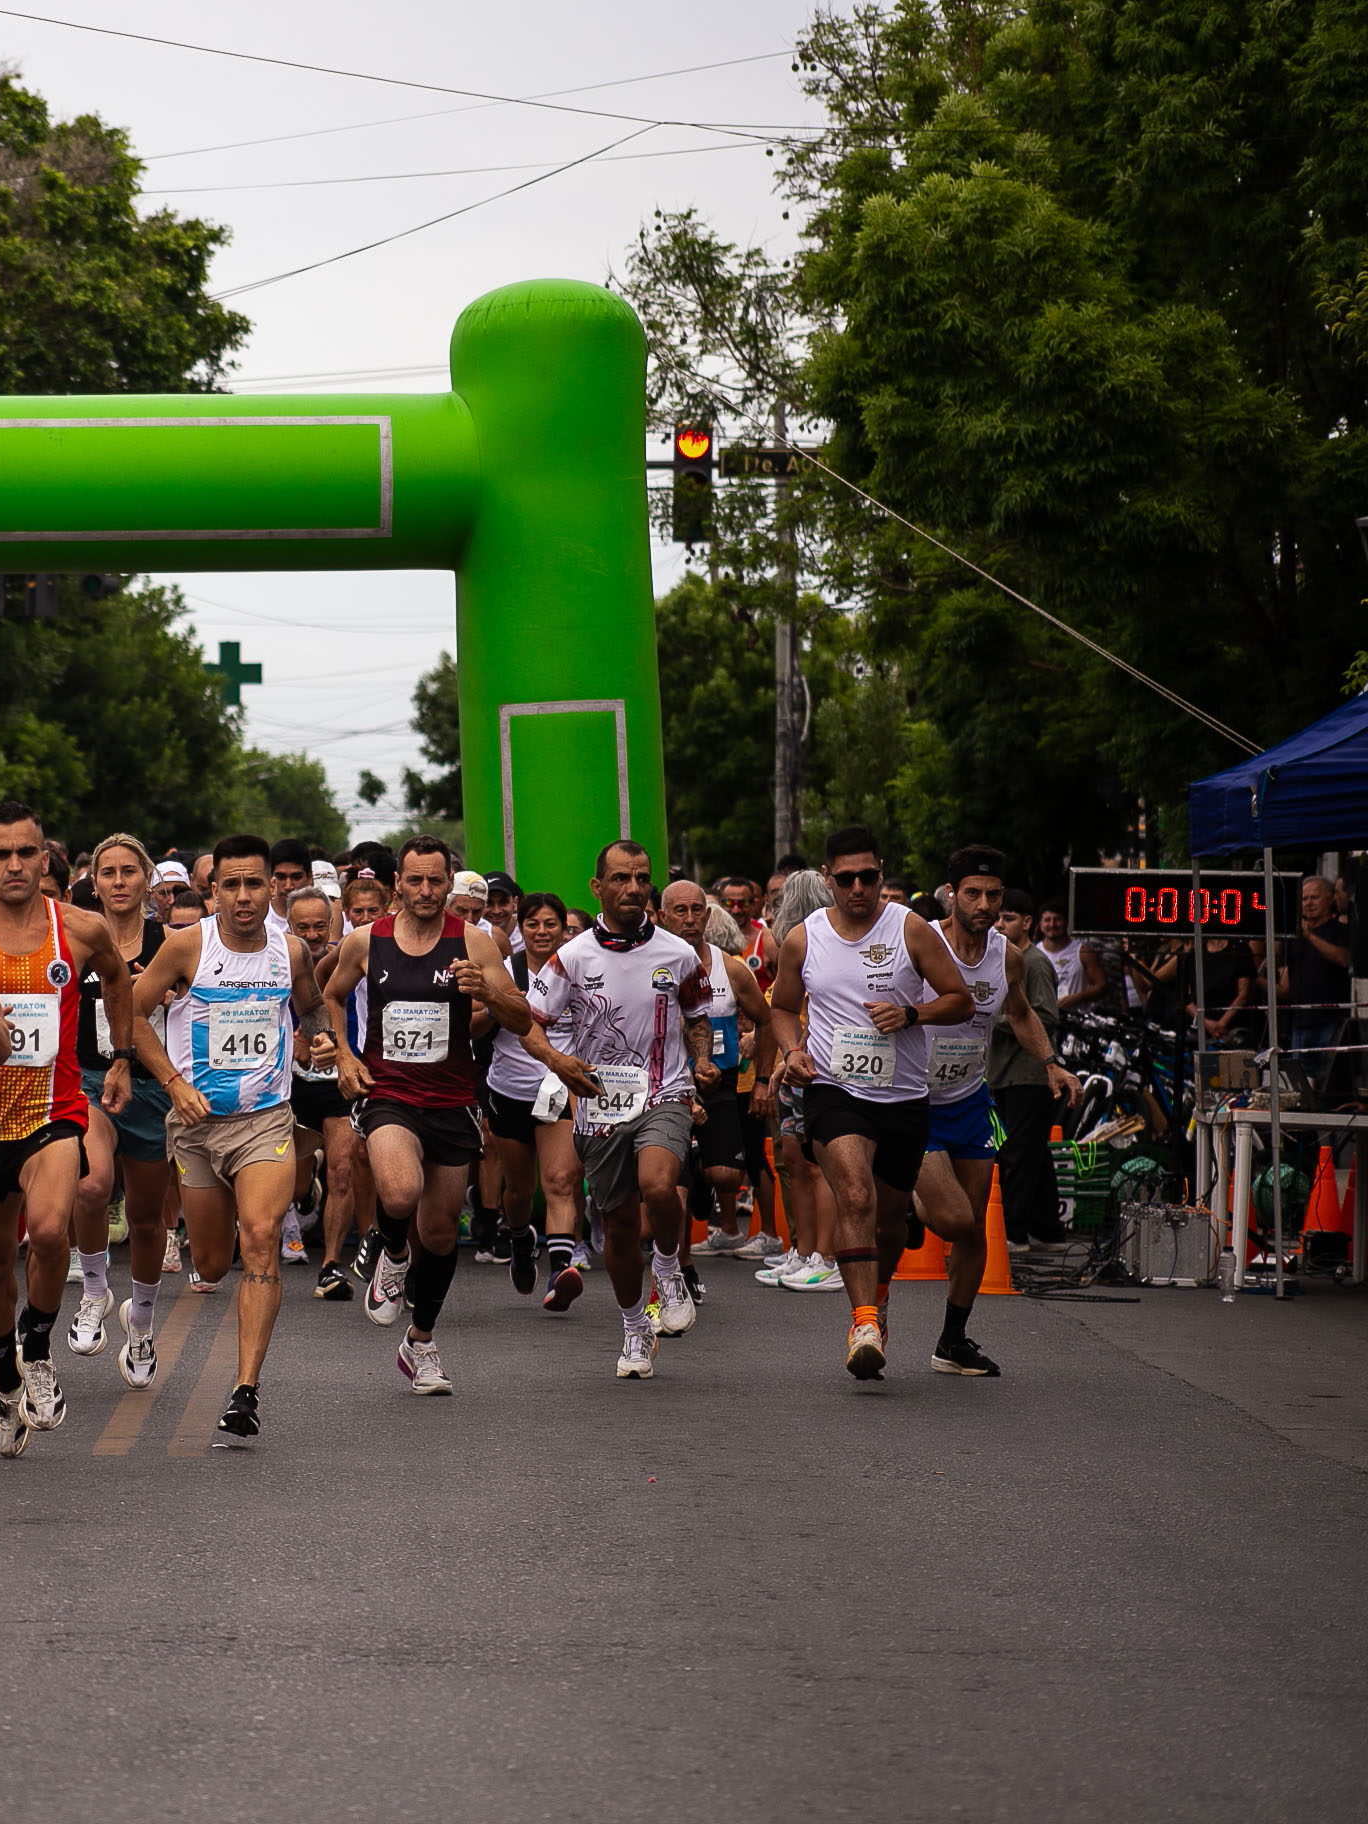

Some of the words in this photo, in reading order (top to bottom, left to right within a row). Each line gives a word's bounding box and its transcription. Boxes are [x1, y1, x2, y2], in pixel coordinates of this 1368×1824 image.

[218, 980, 278, 989] ARGENTINA
[220, 1009, 231, 1017] 40
[232, 1009, 270, 1017] MARATON
[402, 1008, 440, 1016] MARATON
[221, 1032, 268, 1056] 416
[393, 1030, 433, 1050] 671
[853, 1033, 889, 1041] MARATON
[841, 1053, 884, 1076] 320
[935, 1063, 970, 1082] 454
[597, 1092, 635, 1112] 644
